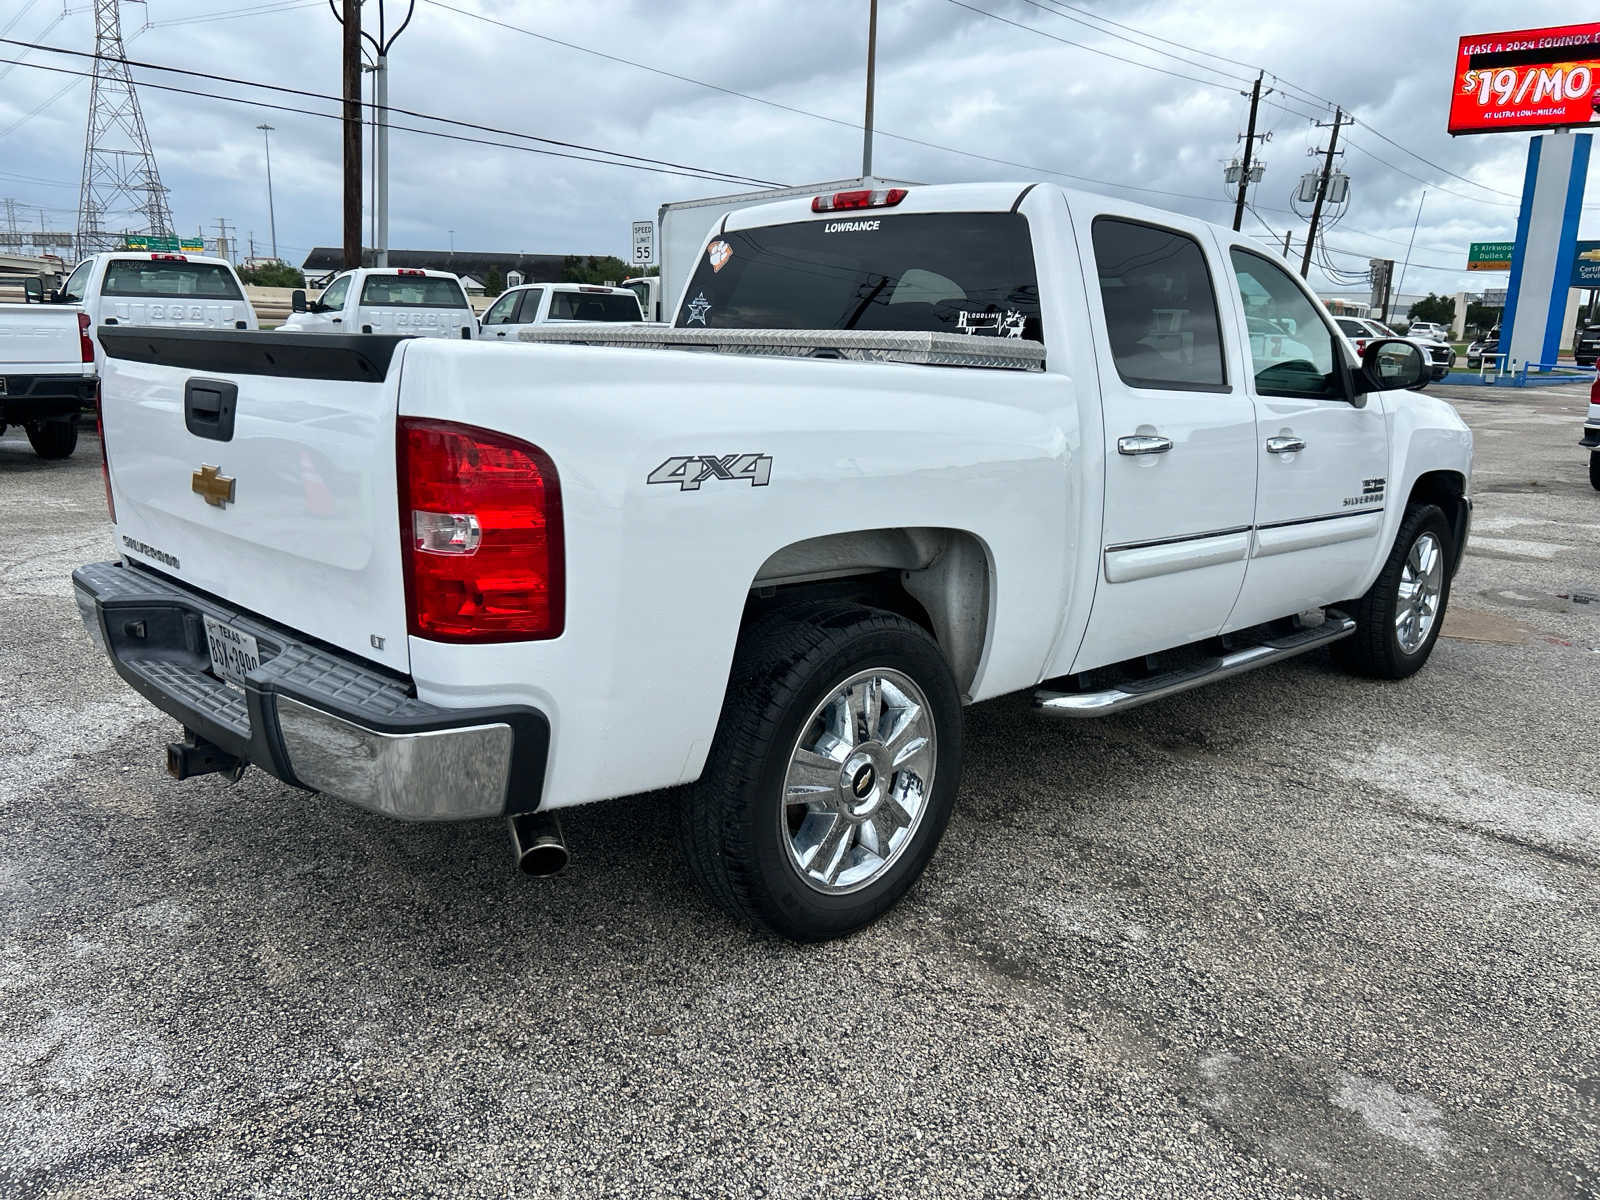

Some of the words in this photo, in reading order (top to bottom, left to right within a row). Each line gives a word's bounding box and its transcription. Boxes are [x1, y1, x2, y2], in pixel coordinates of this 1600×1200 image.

[1463, 43, 1493, 55] LEASE
[1495, 43, 1503, 53] A
[1506, 41, 1535, 52] 2024
[1539, 34, 1590, 49] EQUINOX
[1463, 66, 1592, 106] $19/MO
[1494, 110, 1515, 119] ULTRA
[1516, 107, 1566, 118] LOW-MILEAGE
[634, 226, 652, 234] SPEED
[824, 220, 881, 233] LOWRANCE
[636, 246, 650, 259] 55
[1479, 251, 1504, 259] Dulles
[646, 453, 773, 491] 4X4
[122, 535, 180, 570] SILVERADO
[218, 624, 241, 645] TEXAS
[370, 634, 386, 651] LT
